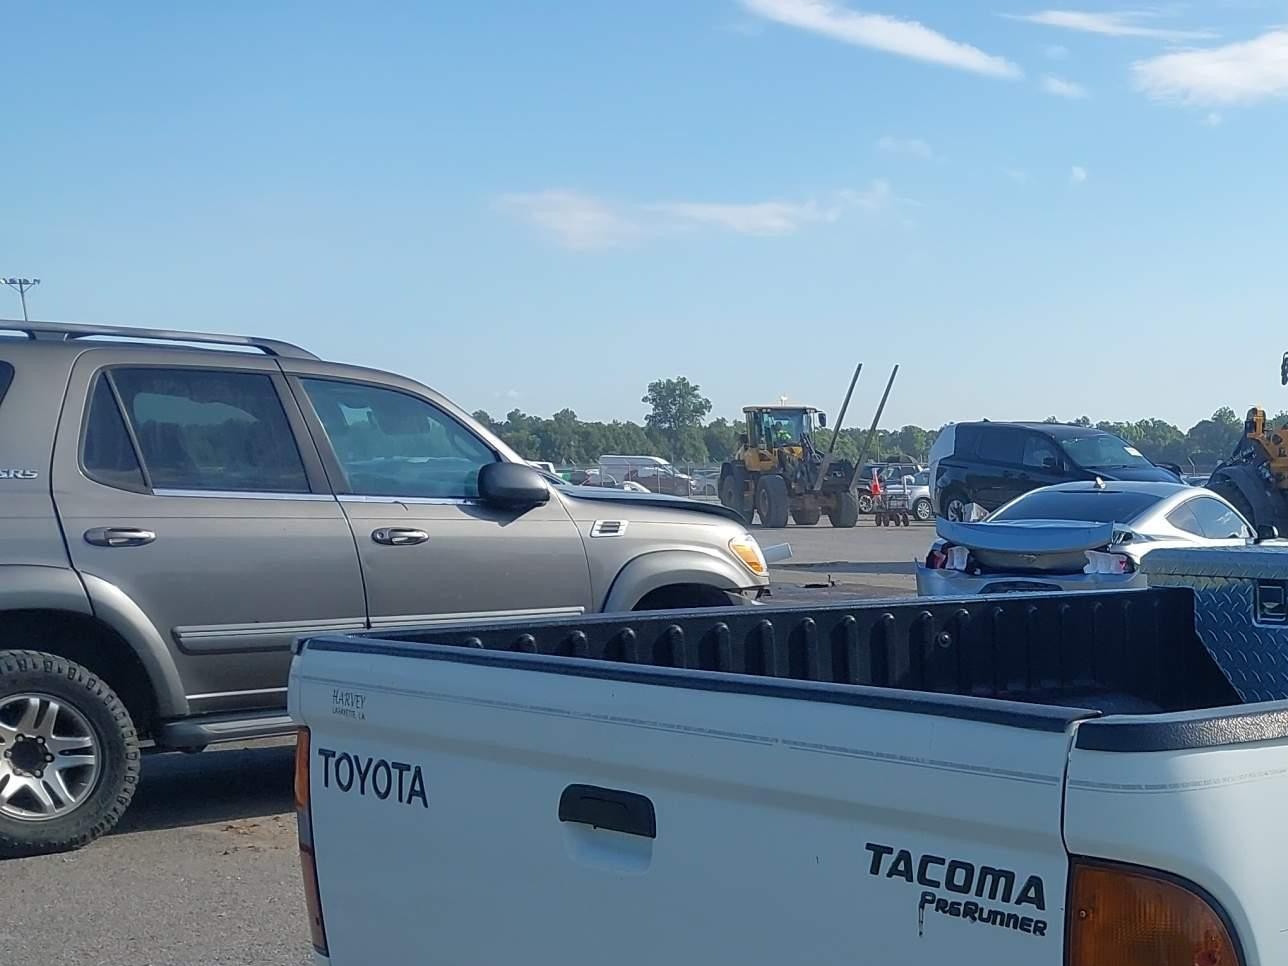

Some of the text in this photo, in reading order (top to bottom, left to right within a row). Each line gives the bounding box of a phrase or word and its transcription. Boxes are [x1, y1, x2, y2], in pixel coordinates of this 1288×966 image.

[332, 689, 366, 709] HARVEY
[318, 747, 429, 809] TOYOTA
[865, 842, 1047, 911] TACOMA
